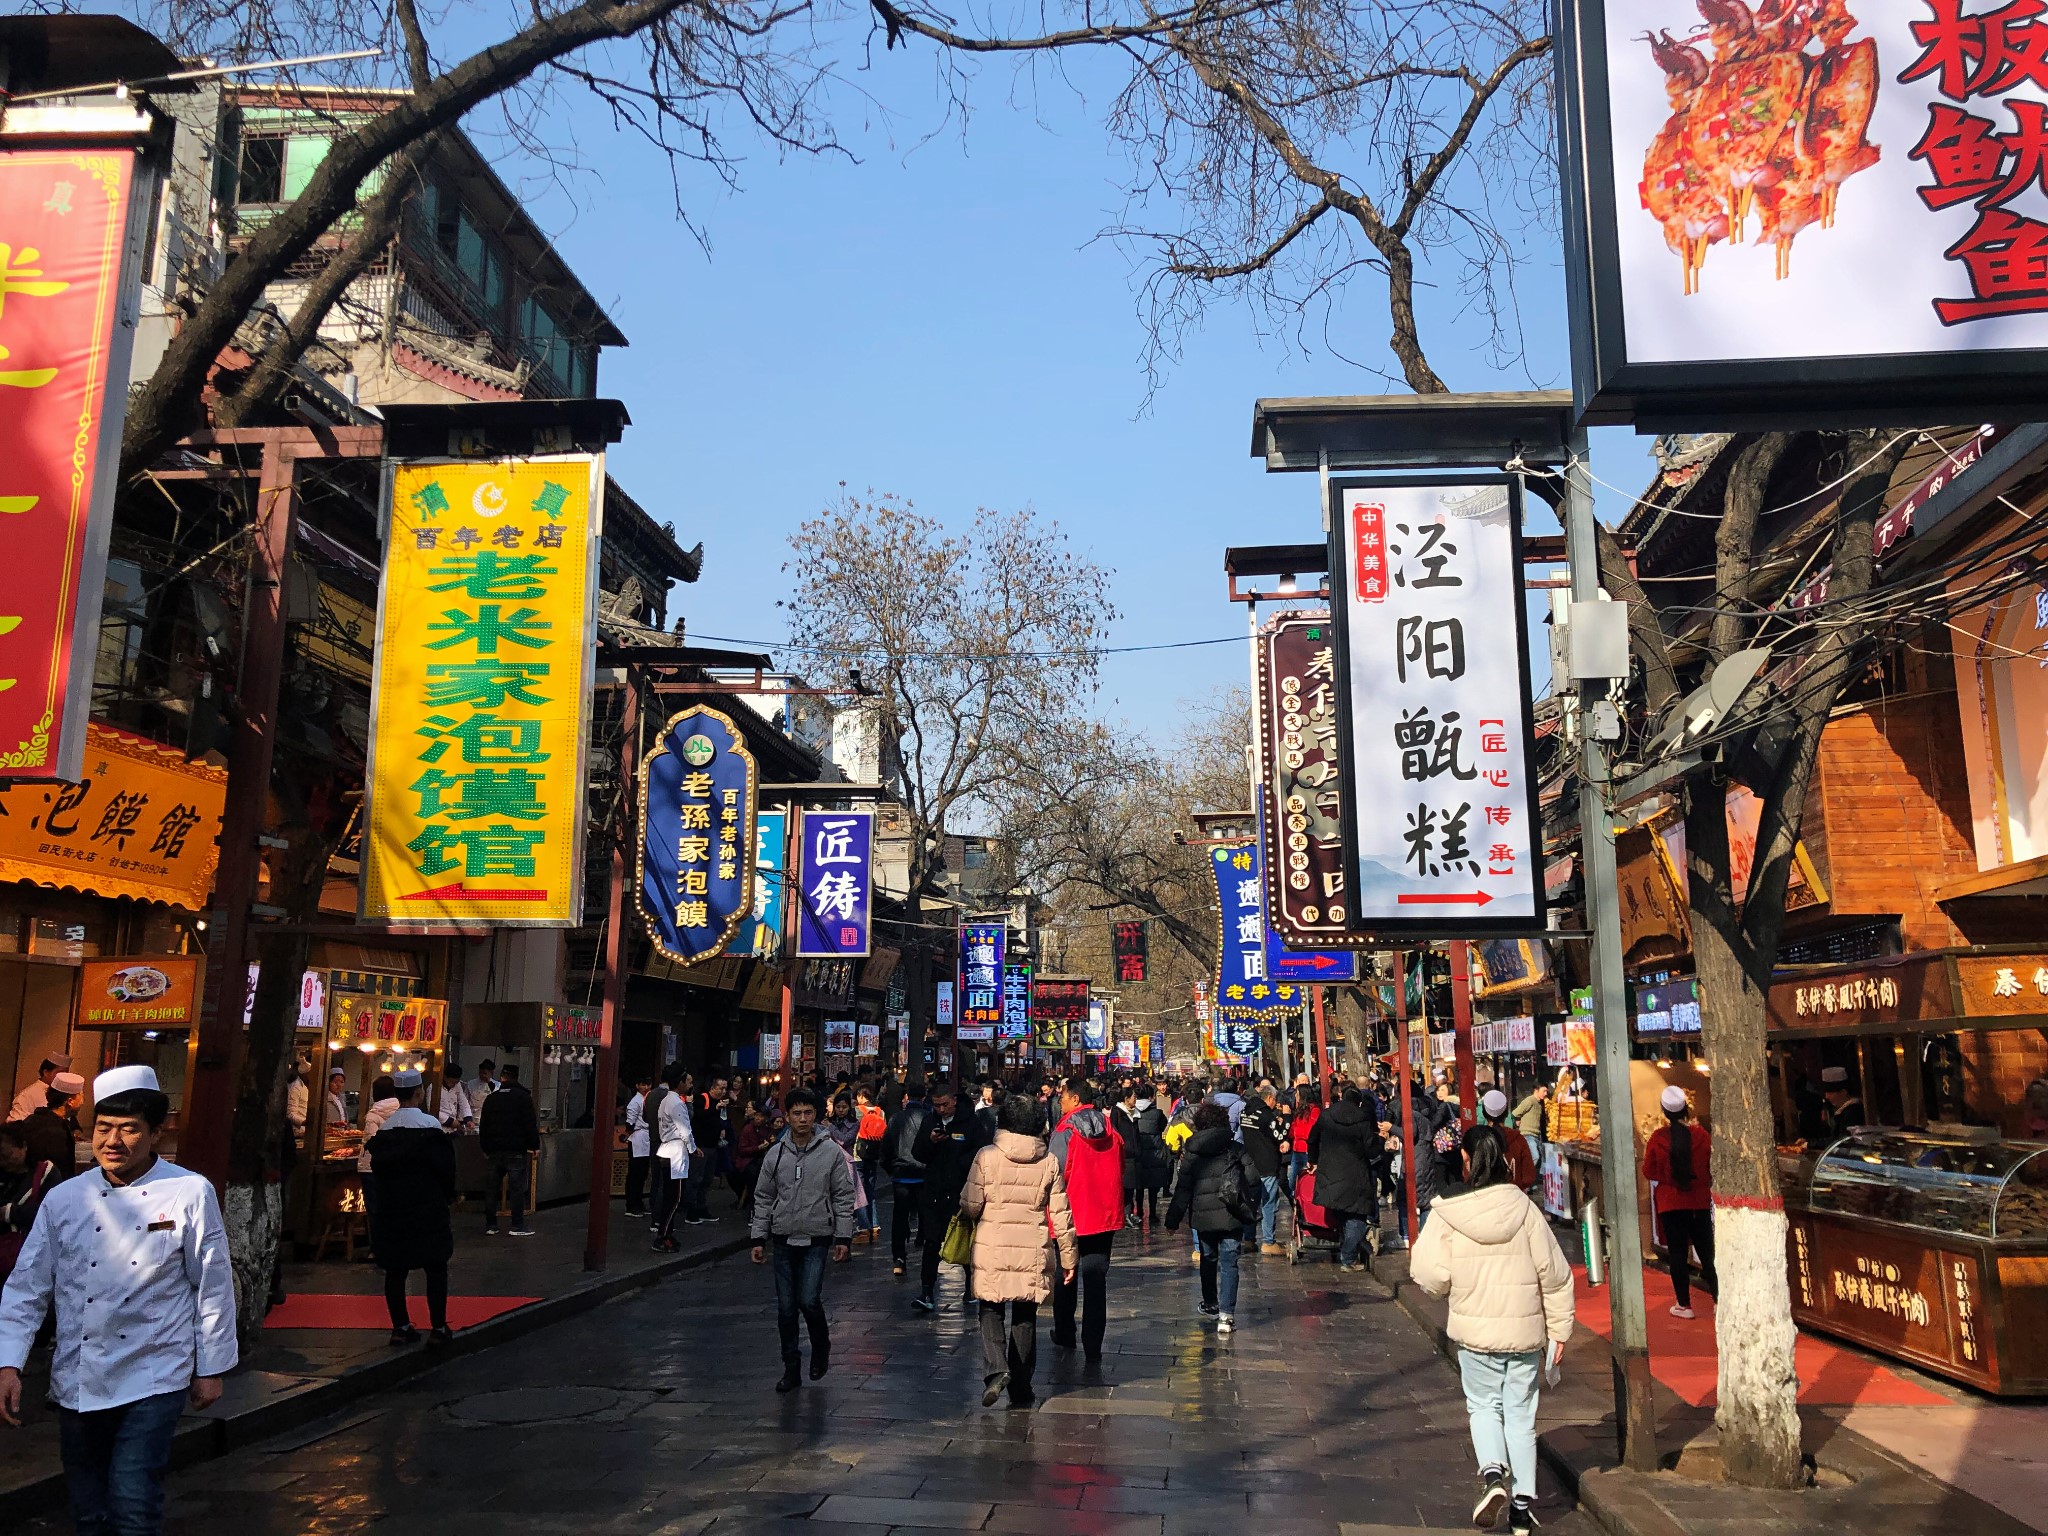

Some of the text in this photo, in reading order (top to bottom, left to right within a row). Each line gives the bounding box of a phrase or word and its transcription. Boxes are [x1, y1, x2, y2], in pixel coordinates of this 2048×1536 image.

[411, 523, 567, 549] 百年老店
[1361, 510, 1381, 595] 中华美食
[405, 551, 558, 878] 老米家泡馍馆
[1390, 523, 1482, 878] 泾阳甑糕
[718, 789, 739, 880] 百年老孙家
[810, 819, 862, 921] 匠铸
[1226, 984, 1295, 1000] 老字号
